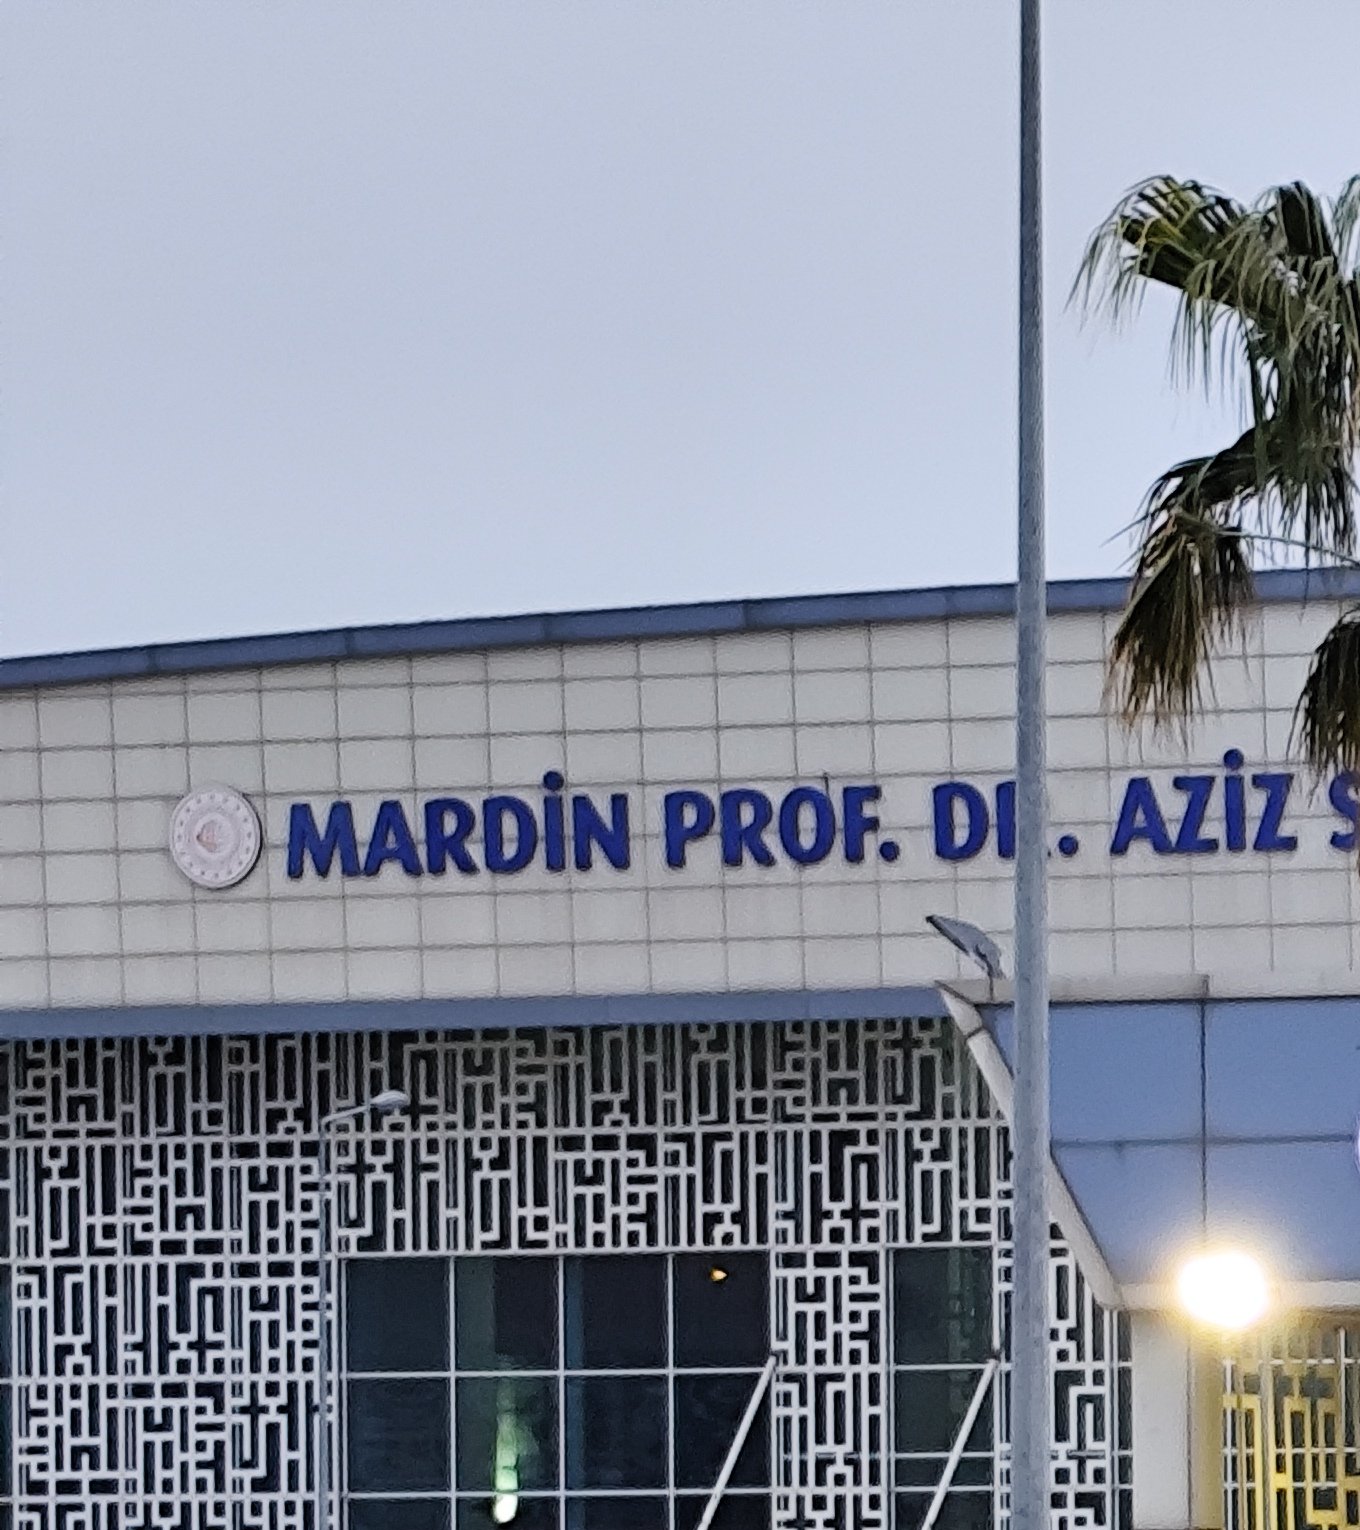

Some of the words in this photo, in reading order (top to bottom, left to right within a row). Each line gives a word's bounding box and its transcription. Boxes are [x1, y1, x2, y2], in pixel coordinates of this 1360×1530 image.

[286, 770, 631, 879] MARDİN
[664, 784, 900, 870] PROF.
[1109, 748, 1298, 857] AZİZ
